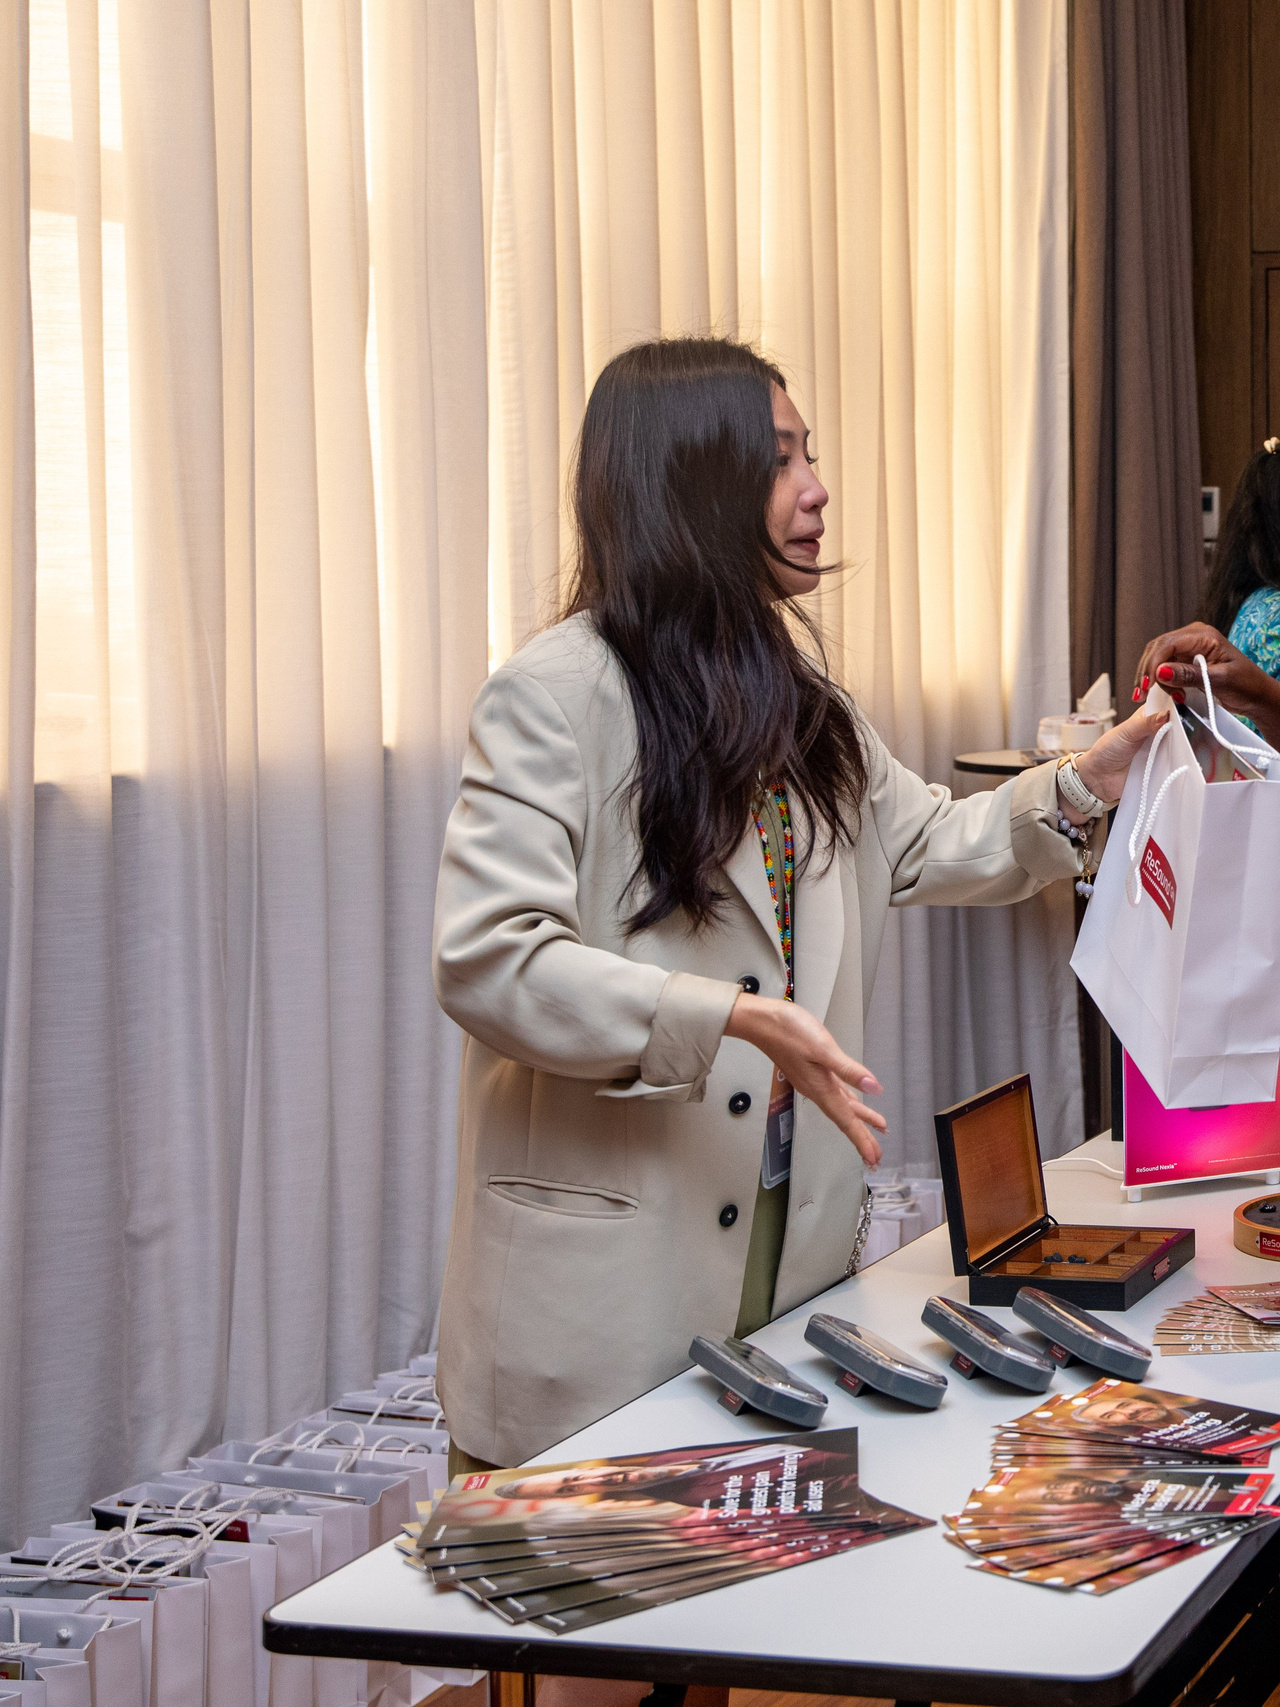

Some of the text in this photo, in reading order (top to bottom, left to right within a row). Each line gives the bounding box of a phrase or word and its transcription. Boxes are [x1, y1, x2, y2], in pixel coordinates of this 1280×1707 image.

[1144, 849, 1171, 896] ReSound
[1136, 1165, 1159, 1173] ReSound
[1159, 1418, 1223, 1441] hearing
[718, 1474, 744, 1518] Solve for the
[750, 1470, 775, 1516] greatest pain
[775, 1453, 804, 1514] points for hearing
[803, 1480, 824, 1513] aid users
